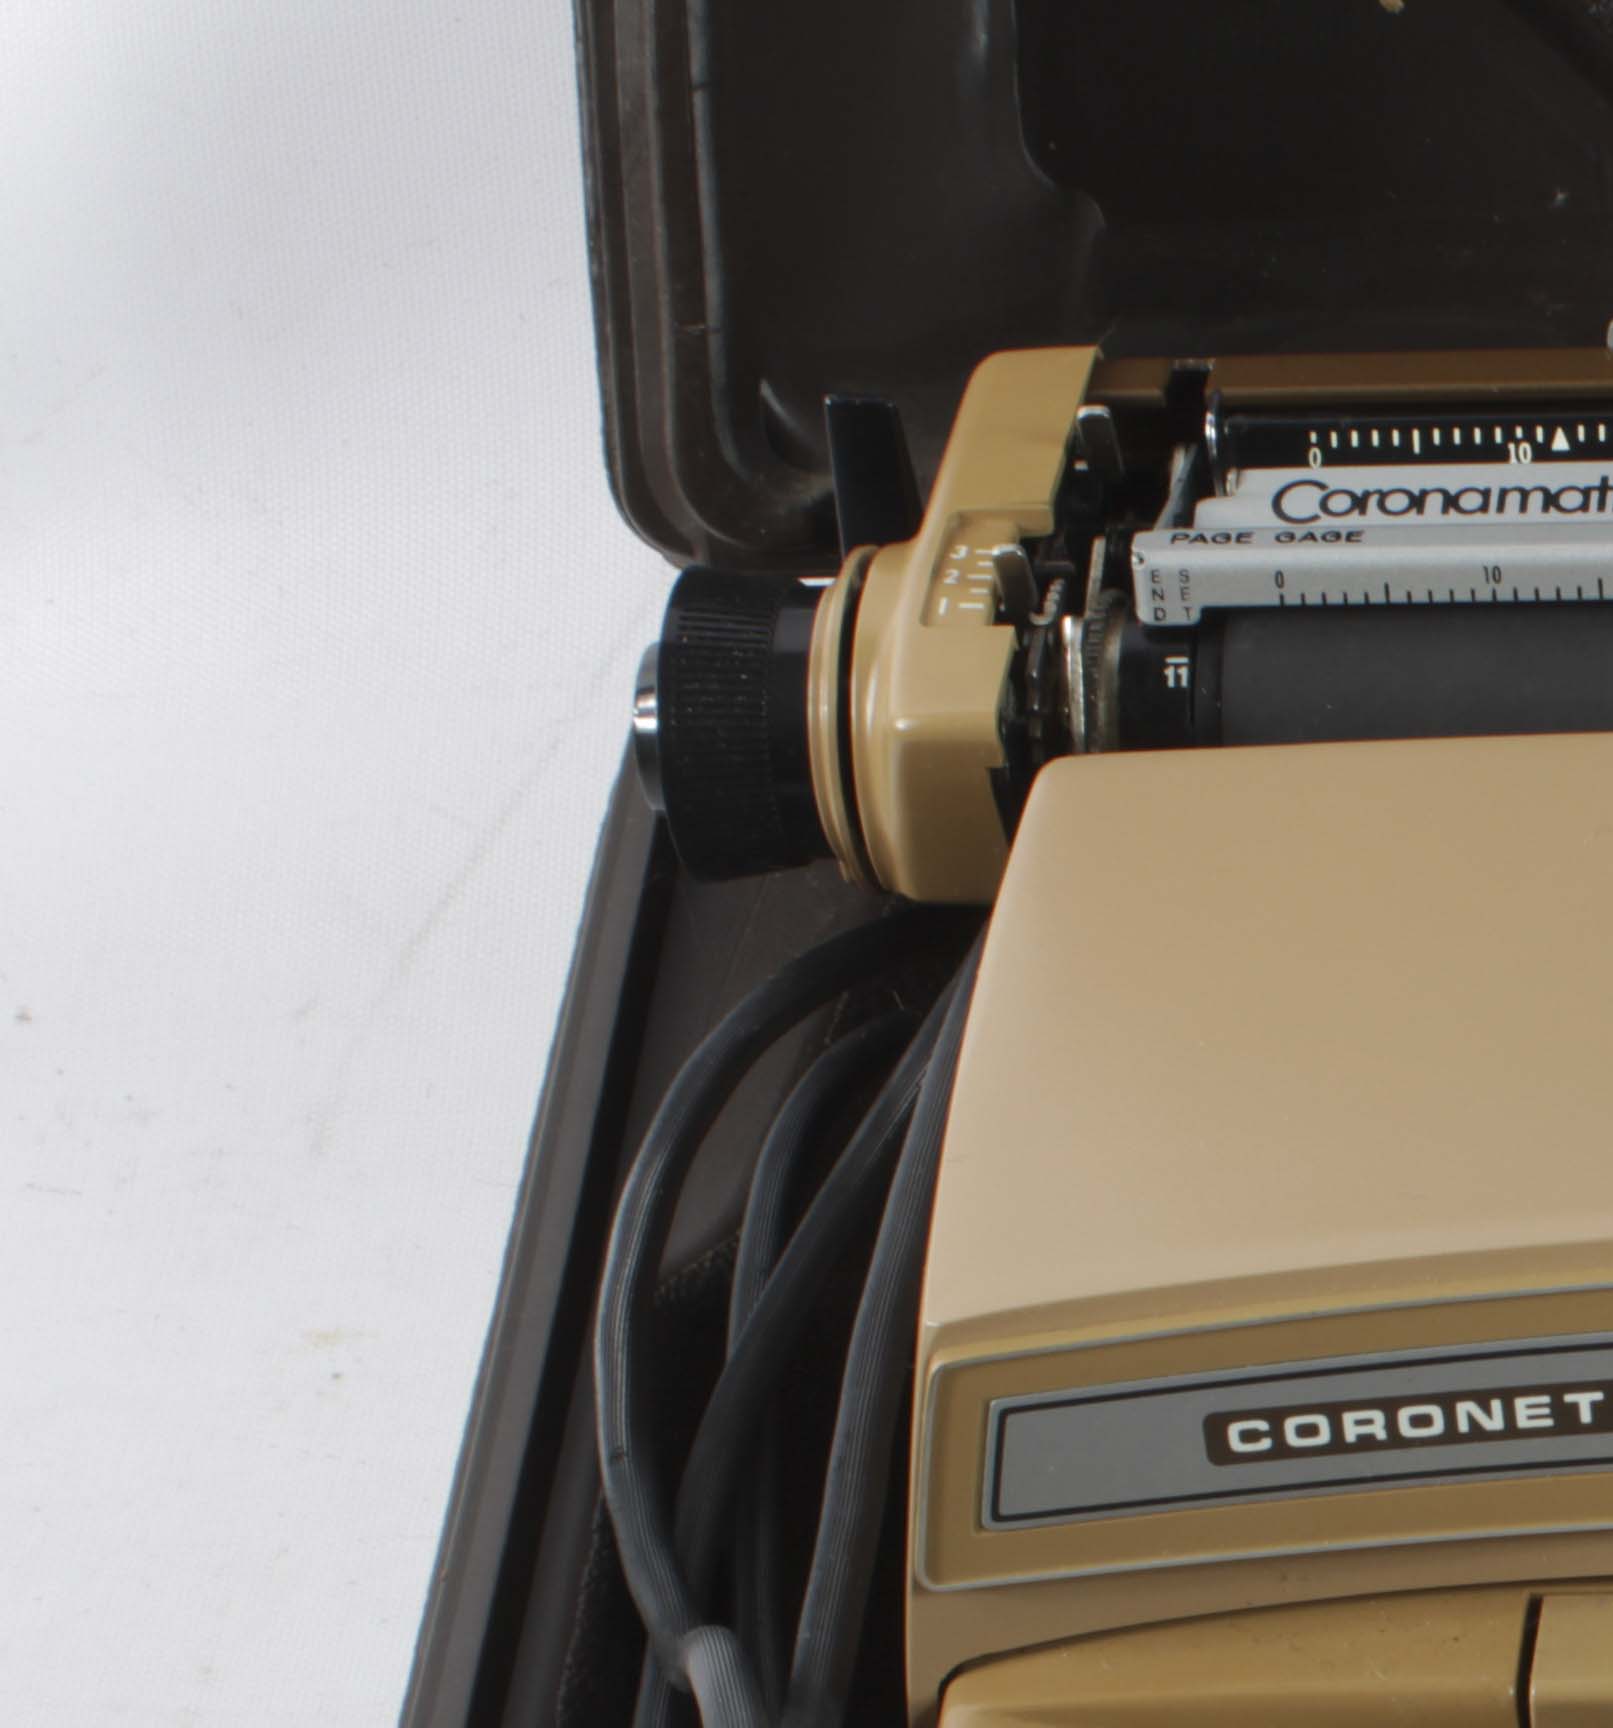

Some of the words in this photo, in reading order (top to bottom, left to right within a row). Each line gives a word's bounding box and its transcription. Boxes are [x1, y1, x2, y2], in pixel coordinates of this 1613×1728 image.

[1309, 447, 1322, 470] 0
[1508, 441, 1532, 464] 10
[1170, 531, 1254, 545] PAGE
[1275, 530, 1364, 544] GAGE
[950, 545, 968, 560] 3
[944, 570, 959, 584] 2
[1274, 570, 1285, 589] 0
[1482, 566, 1502, 584] 10
[939, 598, 947, 616] 1
[1164, 665, 1189, 688] 11
[1224, 1391, 1606, 1455] CORONET
